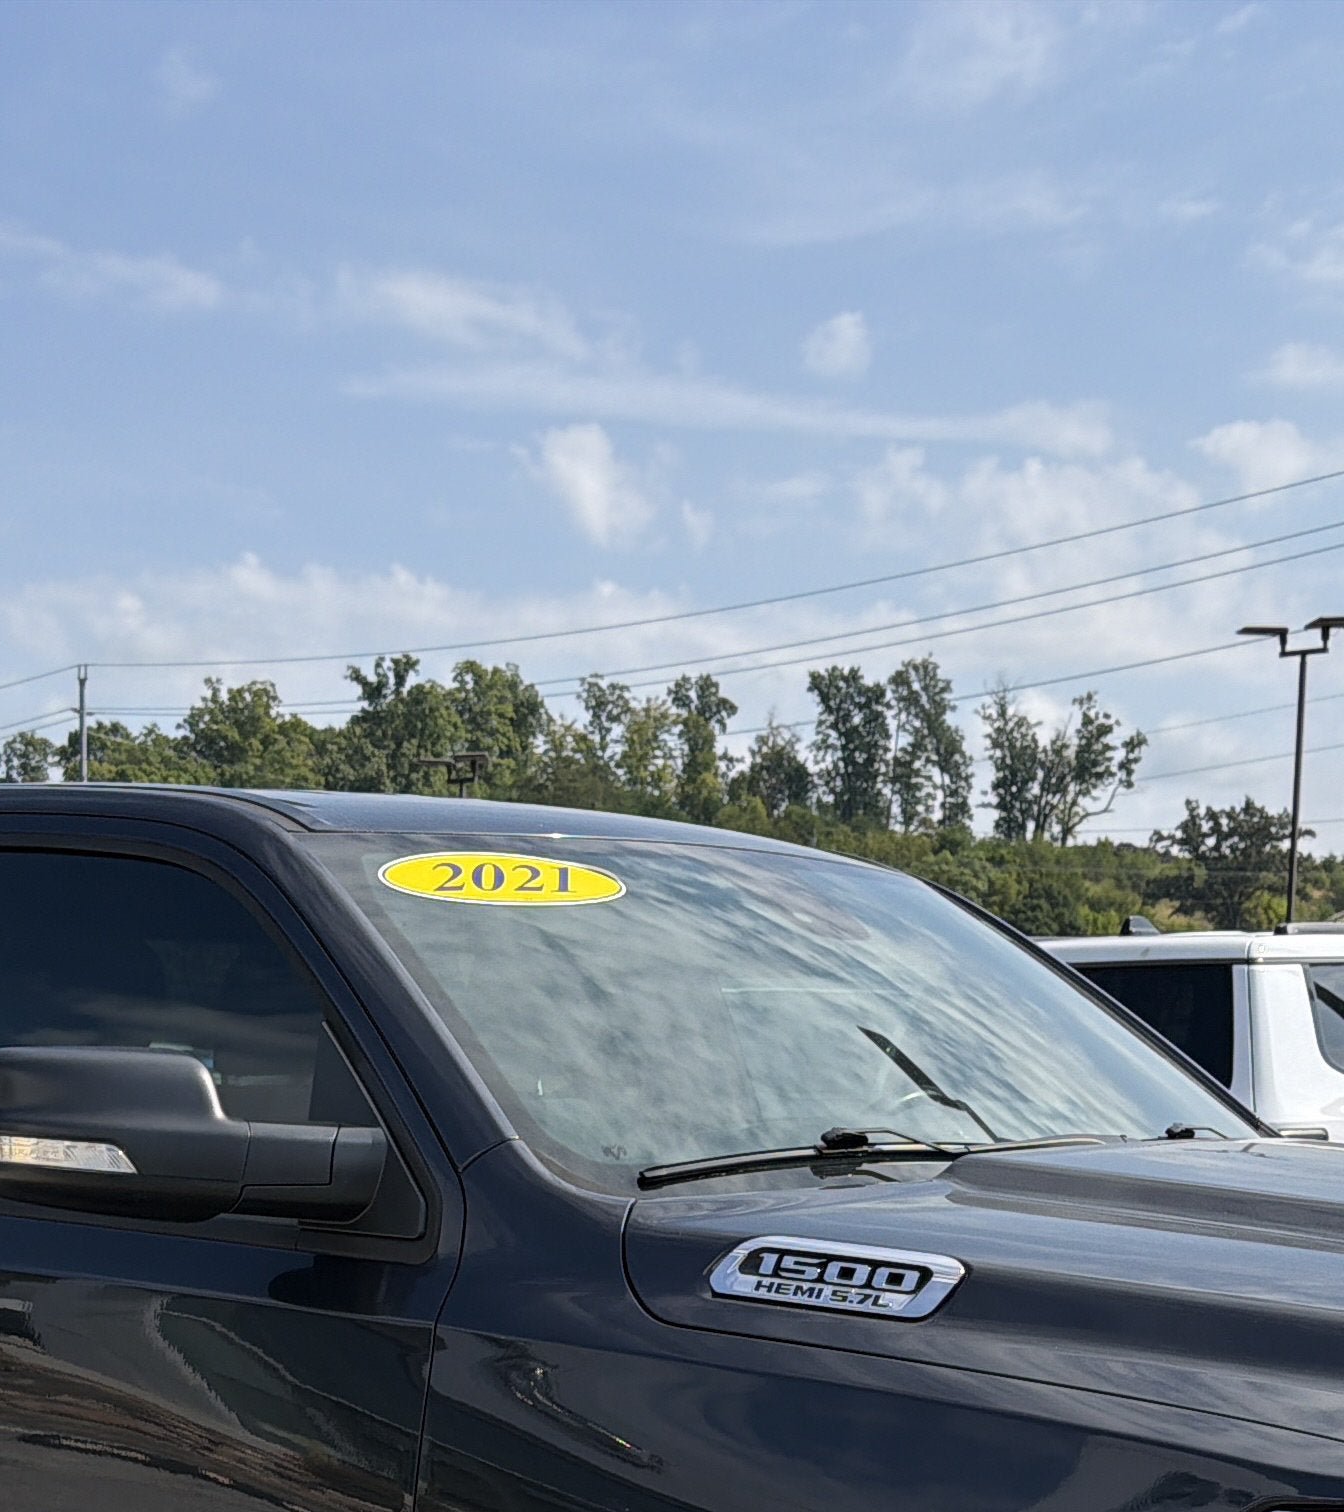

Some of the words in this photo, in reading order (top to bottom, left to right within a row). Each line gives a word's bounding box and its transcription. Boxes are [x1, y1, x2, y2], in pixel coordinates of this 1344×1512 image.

[432, 863, 577, 893] 2021
[757, 1252, 920, 1291] 1500
[754, 1279, 824, 1300] HEMI
[828, 1289, 892, 1308] 5.7L
